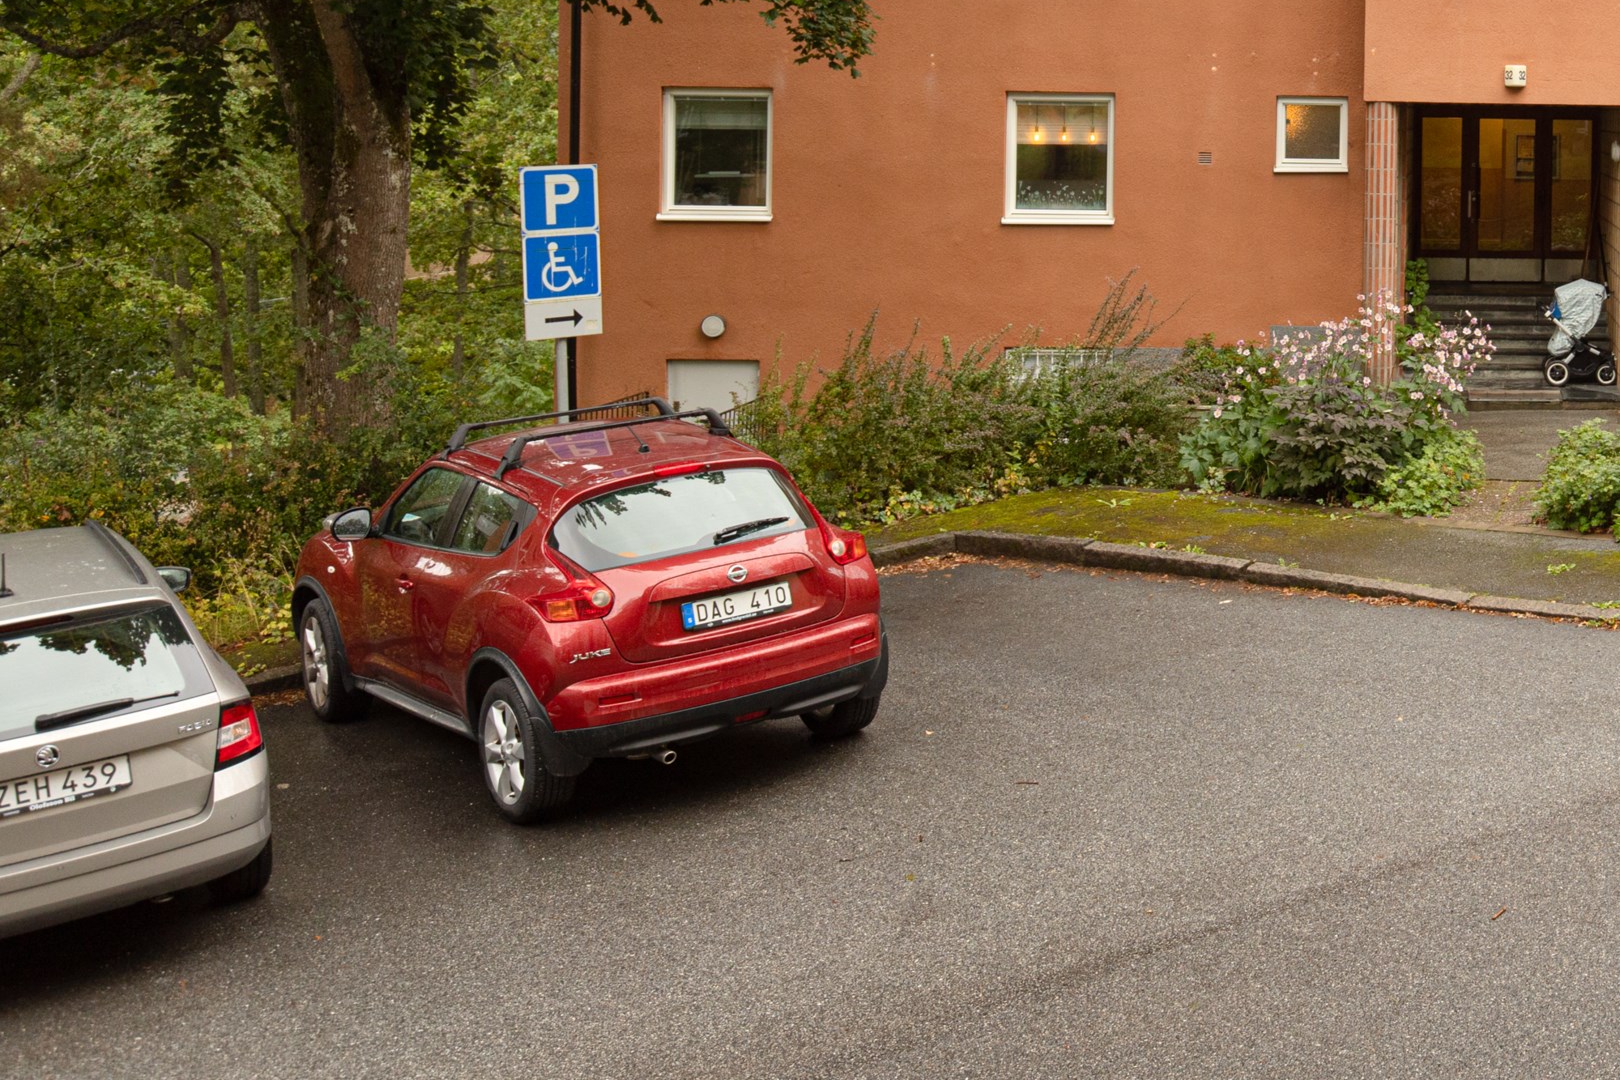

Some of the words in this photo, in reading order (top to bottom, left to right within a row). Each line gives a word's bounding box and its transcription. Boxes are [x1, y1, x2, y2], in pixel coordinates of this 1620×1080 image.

[1505, 70, 1513, 80] 32
[1519, 70, 1526, 80] 32
[544, 173, 580, 226] P
[696, 598, 735, 622] DAG
[750, 586, 787, 610] 410
[569, 647, 611, 664] JUKE
[0, 776, 50, 807] ZEH
[62, 763, 117, 794] 439
